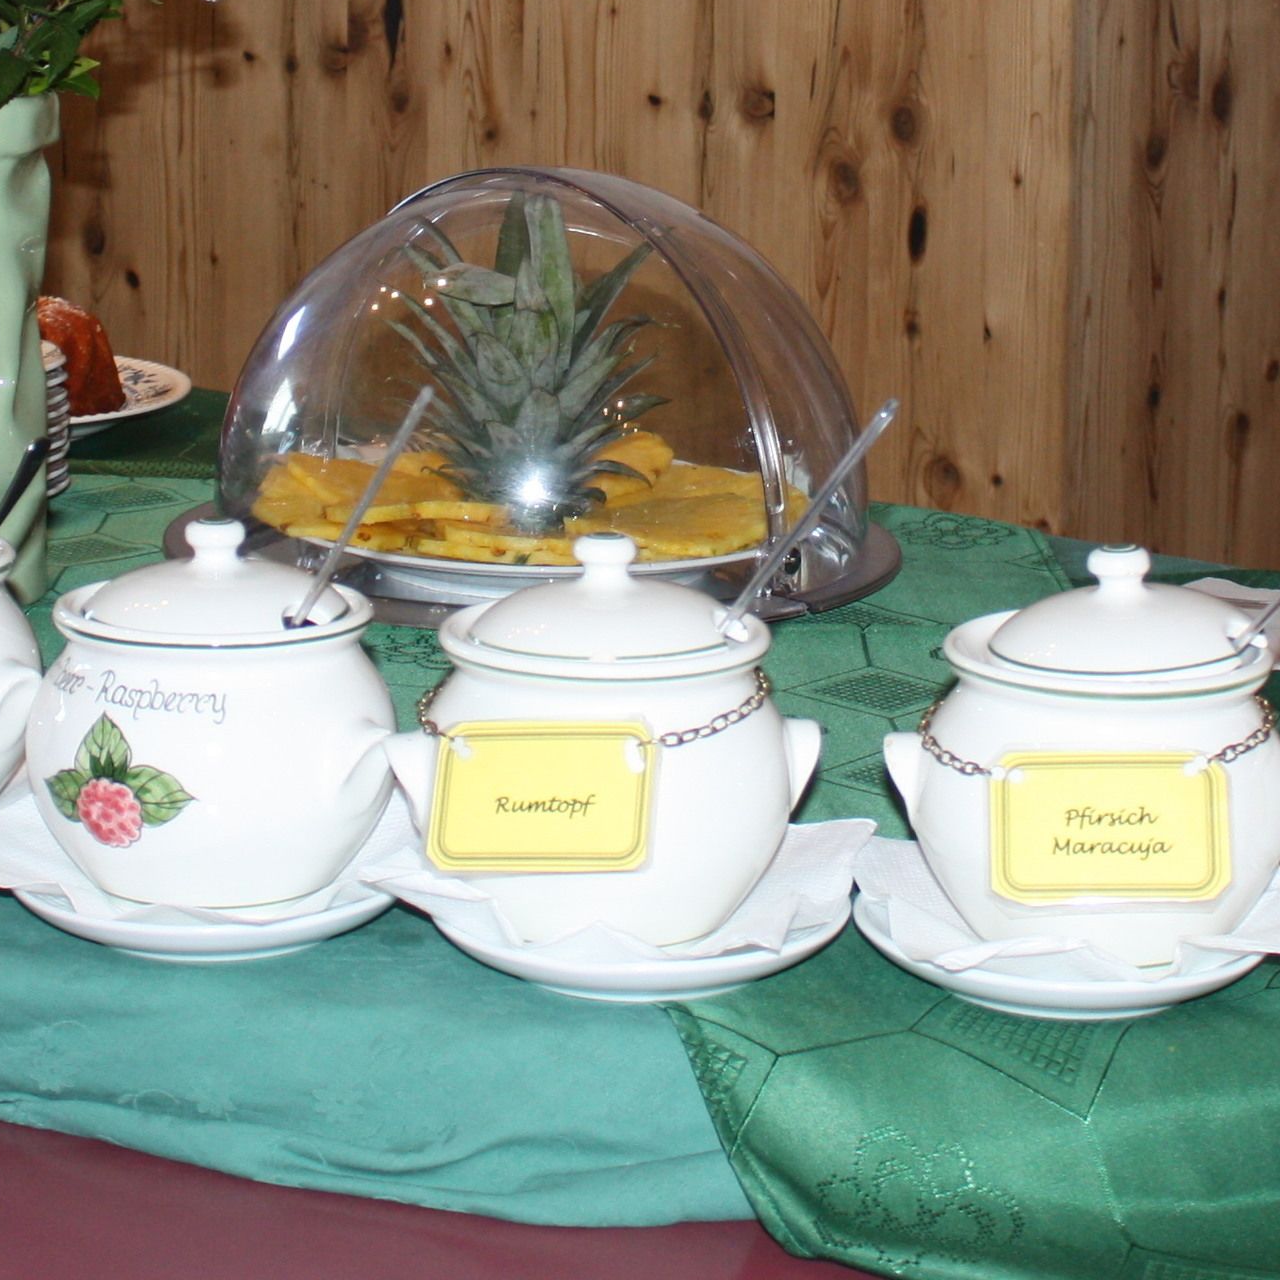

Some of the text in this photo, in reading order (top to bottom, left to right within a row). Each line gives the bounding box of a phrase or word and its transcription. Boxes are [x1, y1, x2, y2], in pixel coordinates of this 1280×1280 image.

[495, 793, 597, 820] Rumtopf
[1064, 805, 1160, 830] Pfirsich
[1051, 836, 1173, 861] Maracuja
